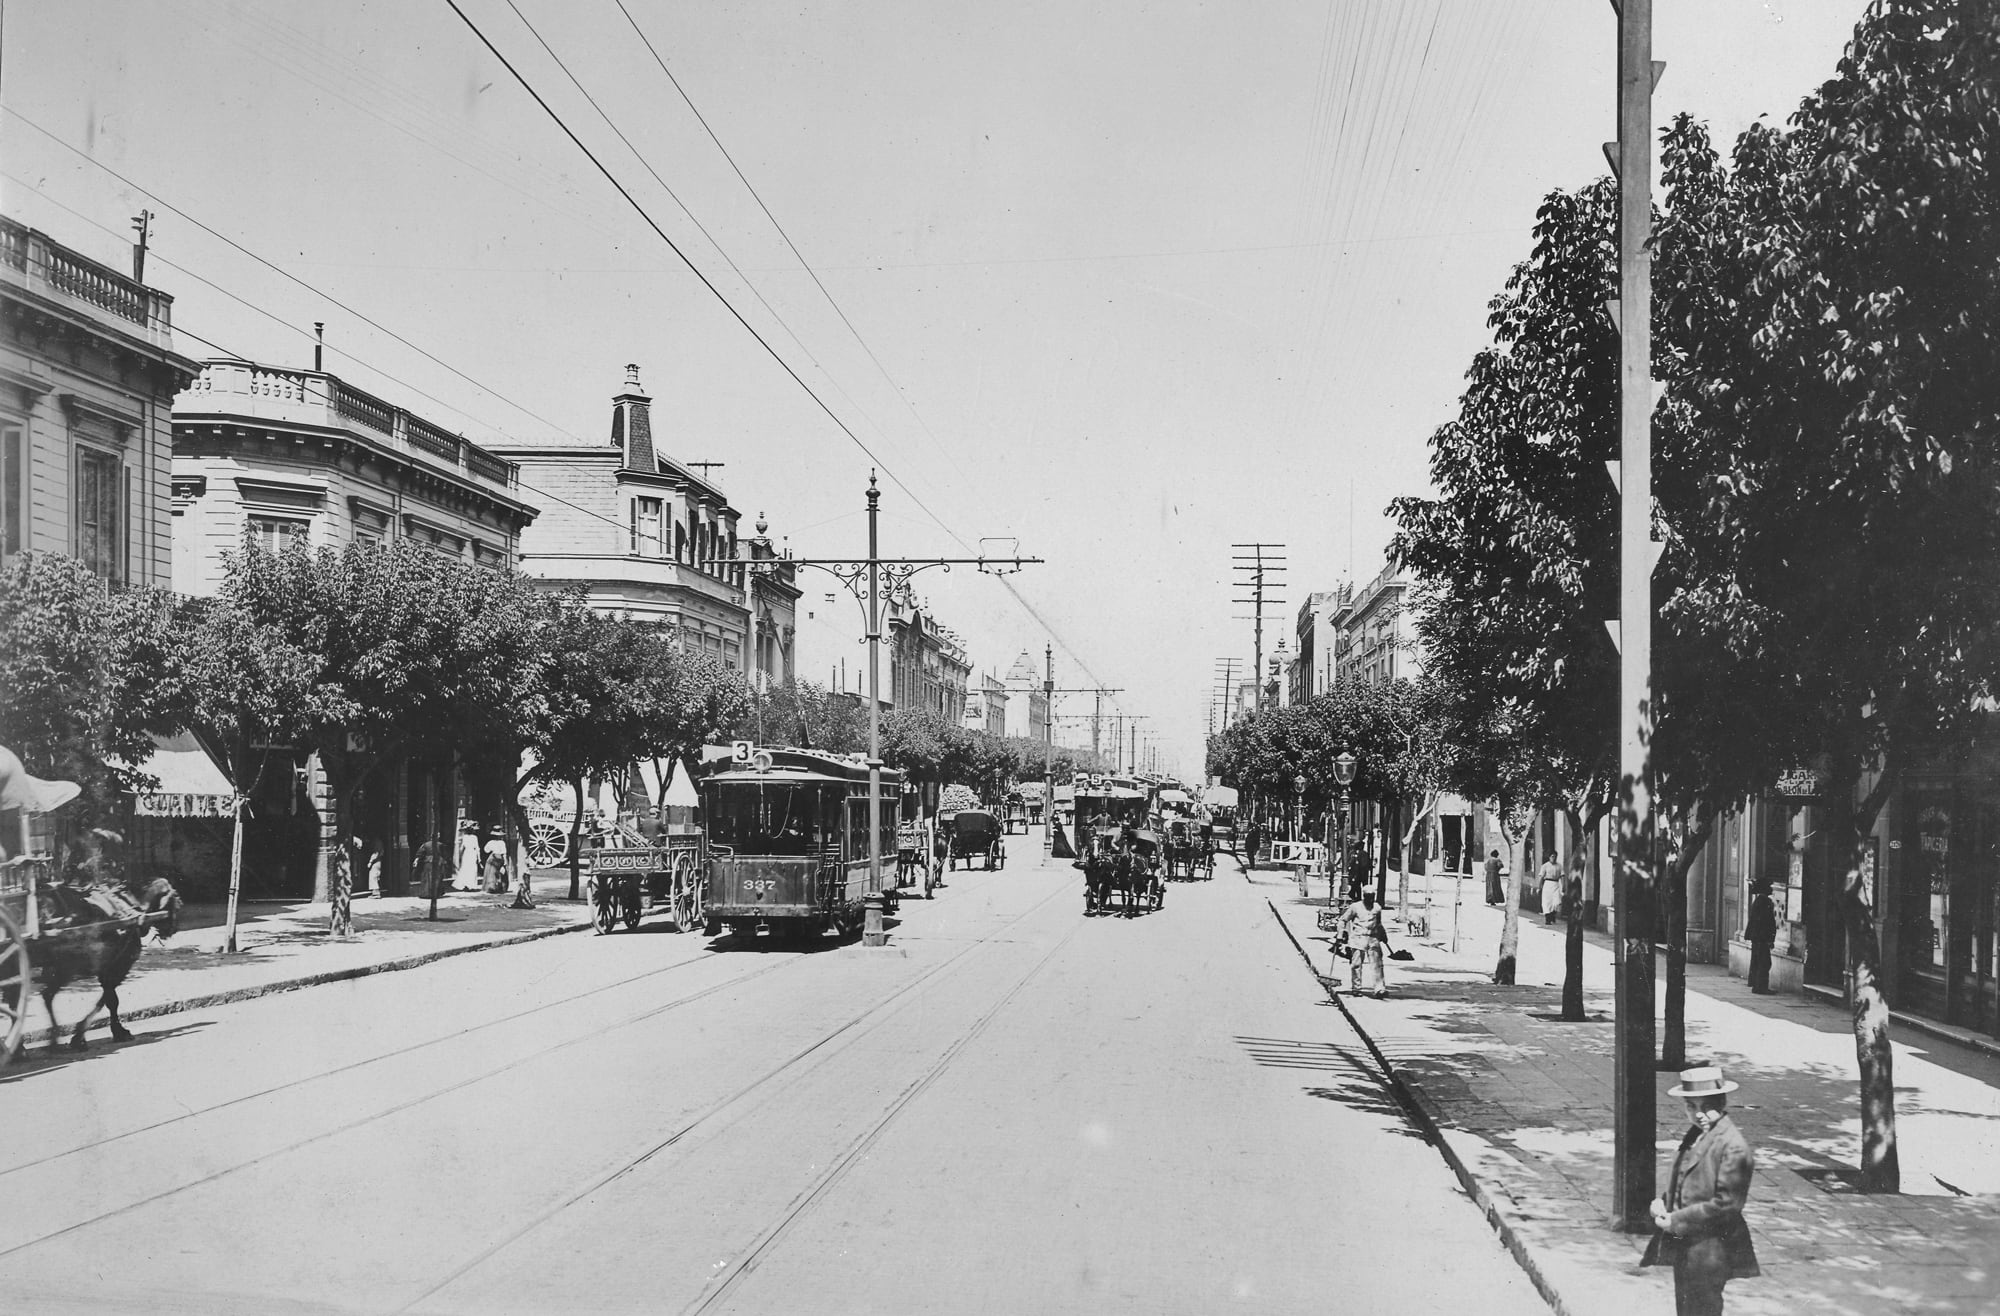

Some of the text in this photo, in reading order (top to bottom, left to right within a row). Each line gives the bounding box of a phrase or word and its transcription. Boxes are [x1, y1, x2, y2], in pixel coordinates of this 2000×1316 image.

[736, 743, 749, 761] 3
[1093, 774, 1100, 784] 5
[743, 879, 776, 891] 337
